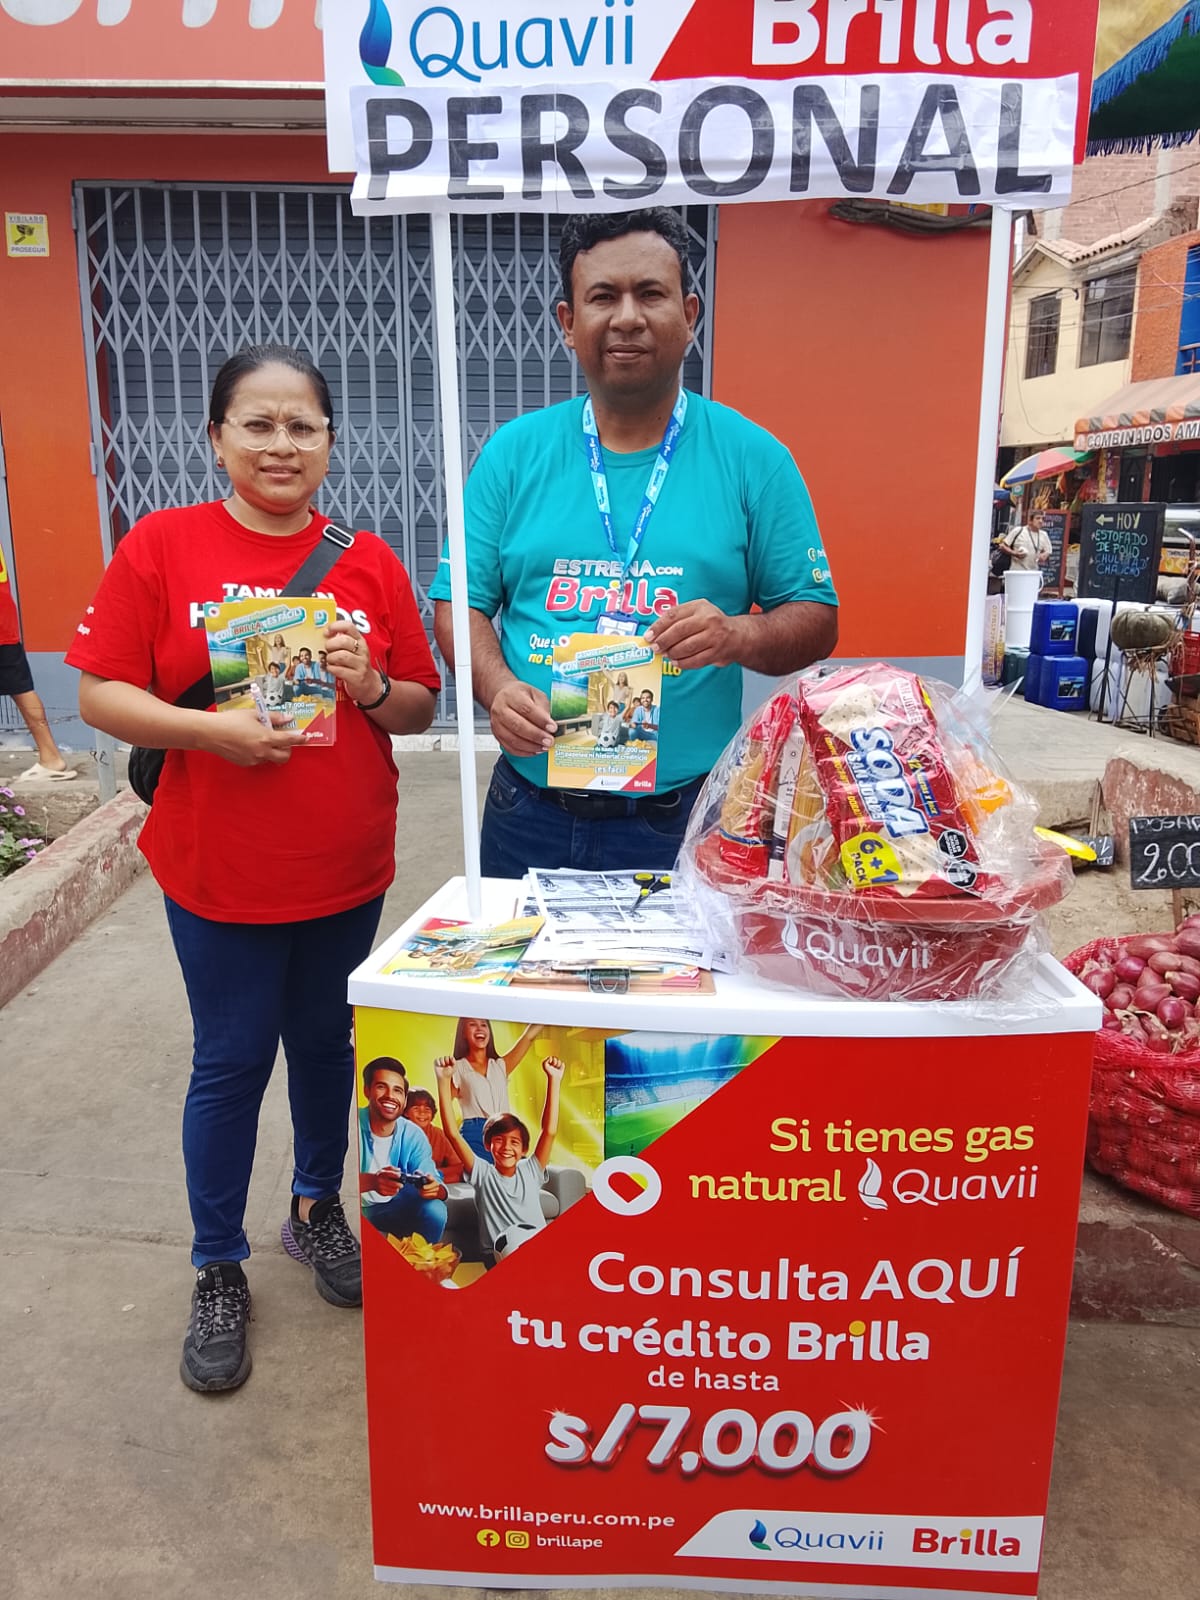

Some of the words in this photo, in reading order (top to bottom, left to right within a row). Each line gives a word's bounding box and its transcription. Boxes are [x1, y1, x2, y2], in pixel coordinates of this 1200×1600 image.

[409, 0, 634, 83] Quavii
[751, 0, 1033, 66] Brilla
[366, 83, 1053, 200] PERSONAL
[1086, 423, 1171, 448] COMBINADOS
[1175, 420, 1200, 439] AM
[1116, 512, 1141, 529] HOY
[1095, 529, 1148, 546] ESTOFADO
[1096, 541, 1110, 552] DE
[553, 559, 656, 577] ESTRENA
[655, 567, 683, 575] CON
[545, 576, 680, 617] Brilla
[529, 633, 551, 650] Que
[850, 727, 930, 838] SODA
[851, 852, 869, 883] PACK
[805, 931, 930, 969] Quavii
[770, 1117, 811, 1152] Si
[824, 1119, 954, 1153] tienes
[964, 1125, 1035, 1163] gas
[689, 1169, 846, 1202] natural
[892, 1165, 1039, 1206] Quavii
[588, 1251, 849, 1301] Consulta
[859, 1246, 1025, 1304] AQUÍ
[507, 1310, 567, 1350] tu
[578, 1317, 771, 1359] crédito
[787, 1320, 930, 1361] Brilla
[647, 1365, 685, 1388] de
[693, 1367, 780, 1391] hasta
[418, 1502, 676, 1530] www.brillaperu.com.pe
[536, 1534, 603, 1549] brillape
[774, 1526, 884, 1551] Quavii
[912, 1527, 1021, 1556] Brilla
